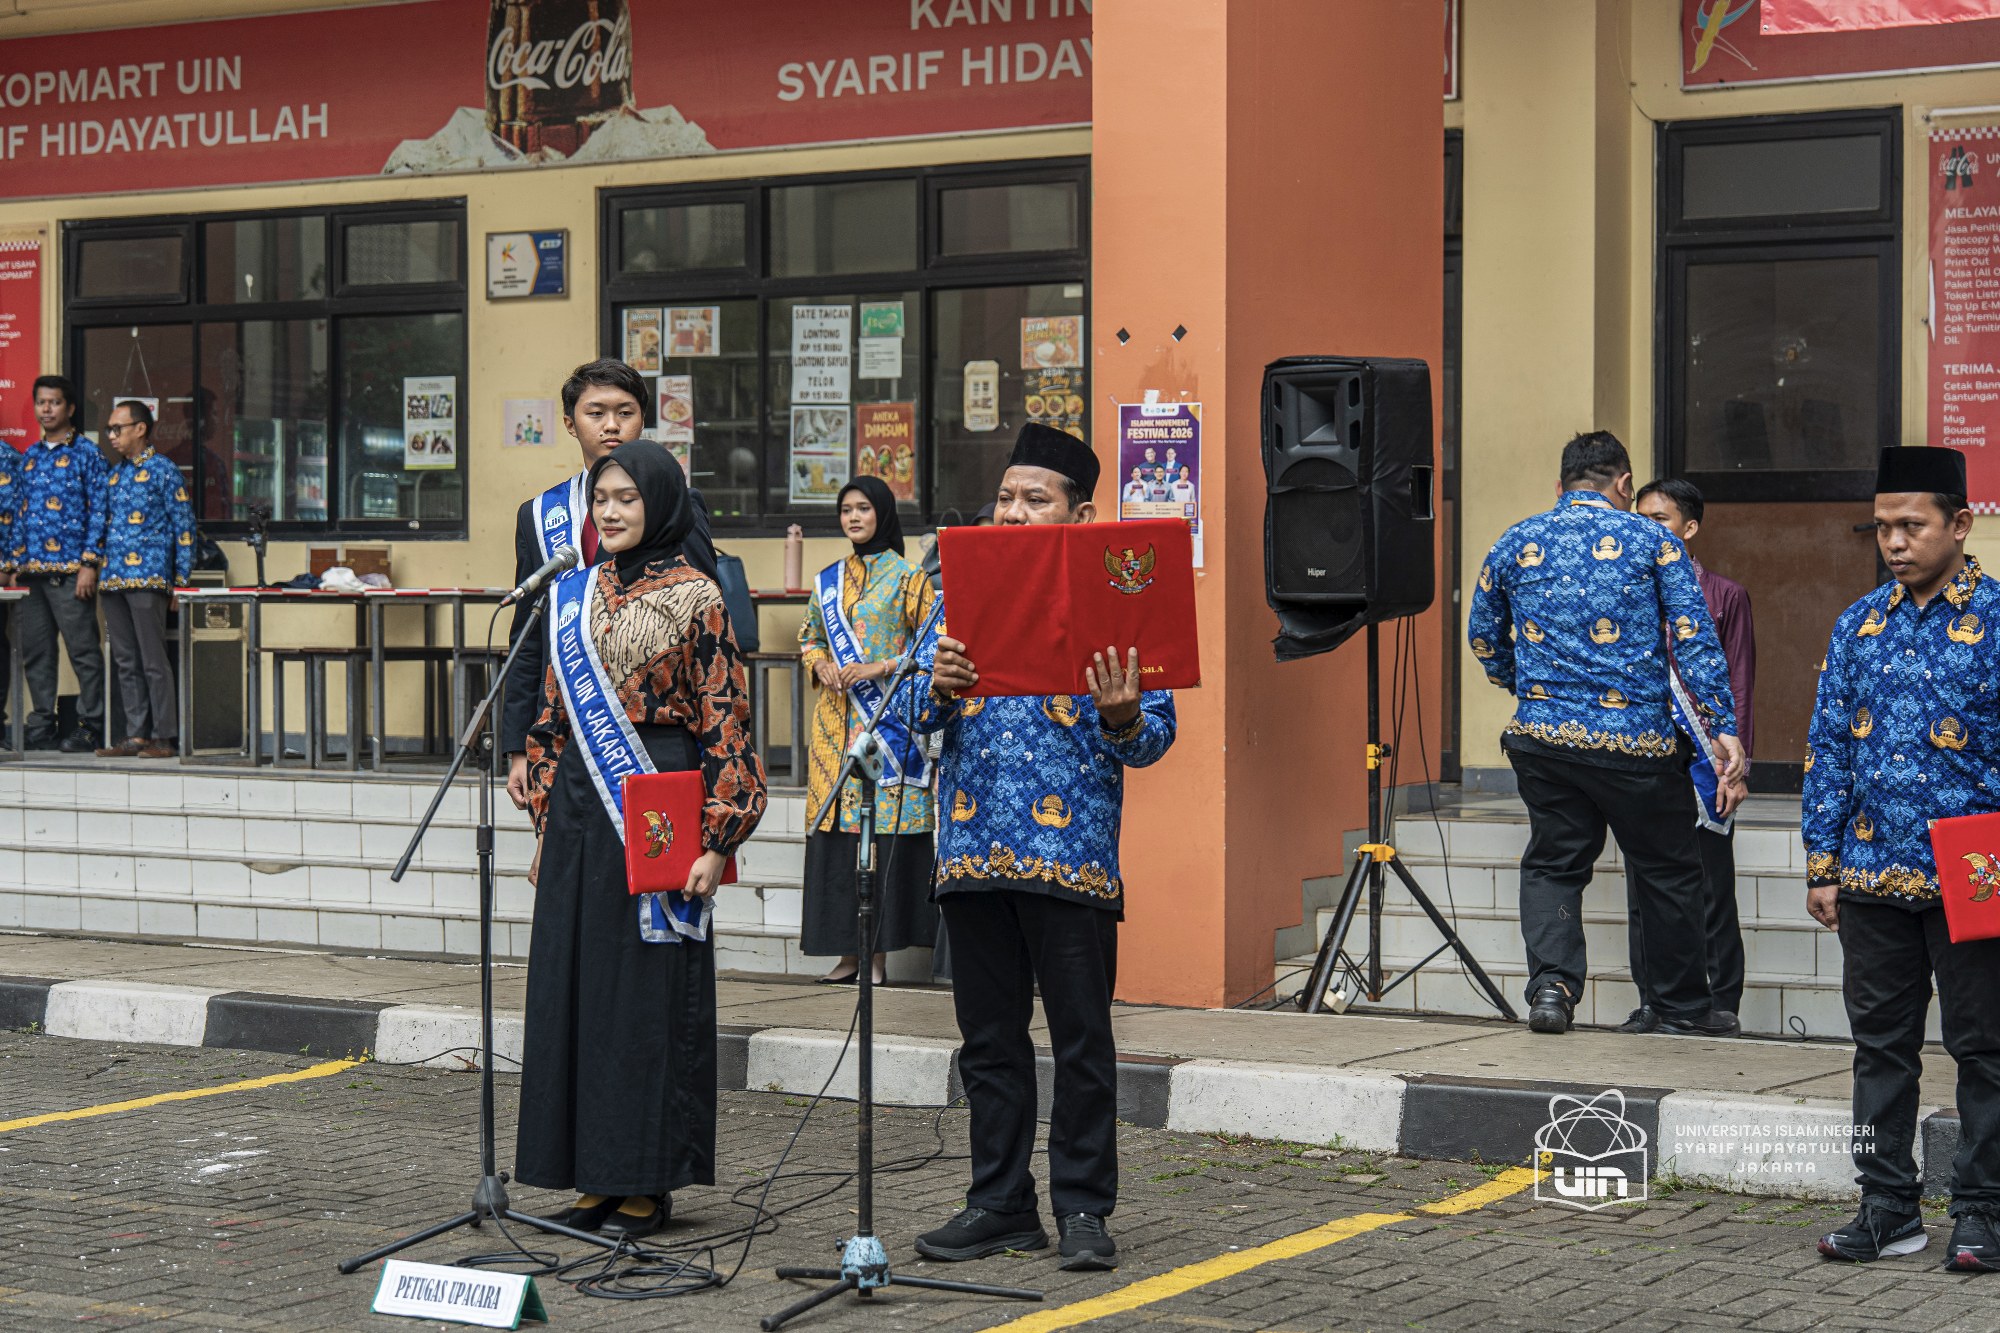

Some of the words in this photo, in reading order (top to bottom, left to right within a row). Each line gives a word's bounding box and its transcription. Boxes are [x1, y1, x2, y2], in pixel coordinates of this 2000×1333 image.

[488, 15, 629, 90] Coca-Cola
[777, 50, 944, 101] SYARIF
[0, 62, 165, 107] OPMART
[176, 55, 242, 94] UIN
[40, 103, 328, 157] HIDAYATULLAH
[1945, 206, 2000, 218] MELAYA
[1945, 224, 1967, 234] Jasa
[1970, 222, 2000, 233] Peniti
[1945, 235, 1990, 245] Fotocopy
[1945, 246, 1990, 256] Fotocopy
[11, 259, 37, 270] USAHA
[1945, 258, 1969, 267] Print
[1971, 257, 1990, 266] Out
[1945, 269, 1972, 278] Pulsa
[1945, 280, 1973, 289] Paket
[1975, 279, 1999, 288] Data
[1944, 291, 1974, 300] Token
[1944, 302, 1962, 312] Top
[1965, 302, 1979, 312] Up
[796, 308, 816, 319] SATE
[820, 308, 849, 319] TAICAN
[1944, 313, 1964, 323] Apk
[803, 329, 840, 339] LONTONG
[1944, 324, 1963, 334] Cek
[824, 343, 843, 352] RIBU
[795, 356, 825, 367] LONTONG
[828, 356, 849, 367] SAYUR
[1943, 363, 1994, 375] TERIMA
[808, 377, 834, 387] TELOR
[1944, 381, 1972, 391] Cetak
[824, 391, 843, 399] RIBU
[1944, 392, 1998, 402] Gantungan
[1944, 404, 1959, 412] Pin
[872, 411, 899, 422] ANEKA
[1944, 415, 1966, 425] Mug
[1155, 419, 1190, 427] MOVEMENT
[864, 423, 909, 438] DIMSUM
[1127, 428, 1169, 439] FESTIVAL
[1170, 427, 1193, 439] 2026
[1944, 425, 1985, 436] Bouquet
[1943, 436, 1985, 447] Catering
[561, 628, 584, 675] DUTA
[573, 673, 597, 705] UIN
[586, 708, 637, 786] JAKARTA
[868, 696, 890, 721] 206
[394, 1275, 448, 1303] PETUGAS
[447, 1281, 501, 1309] UPACARA
